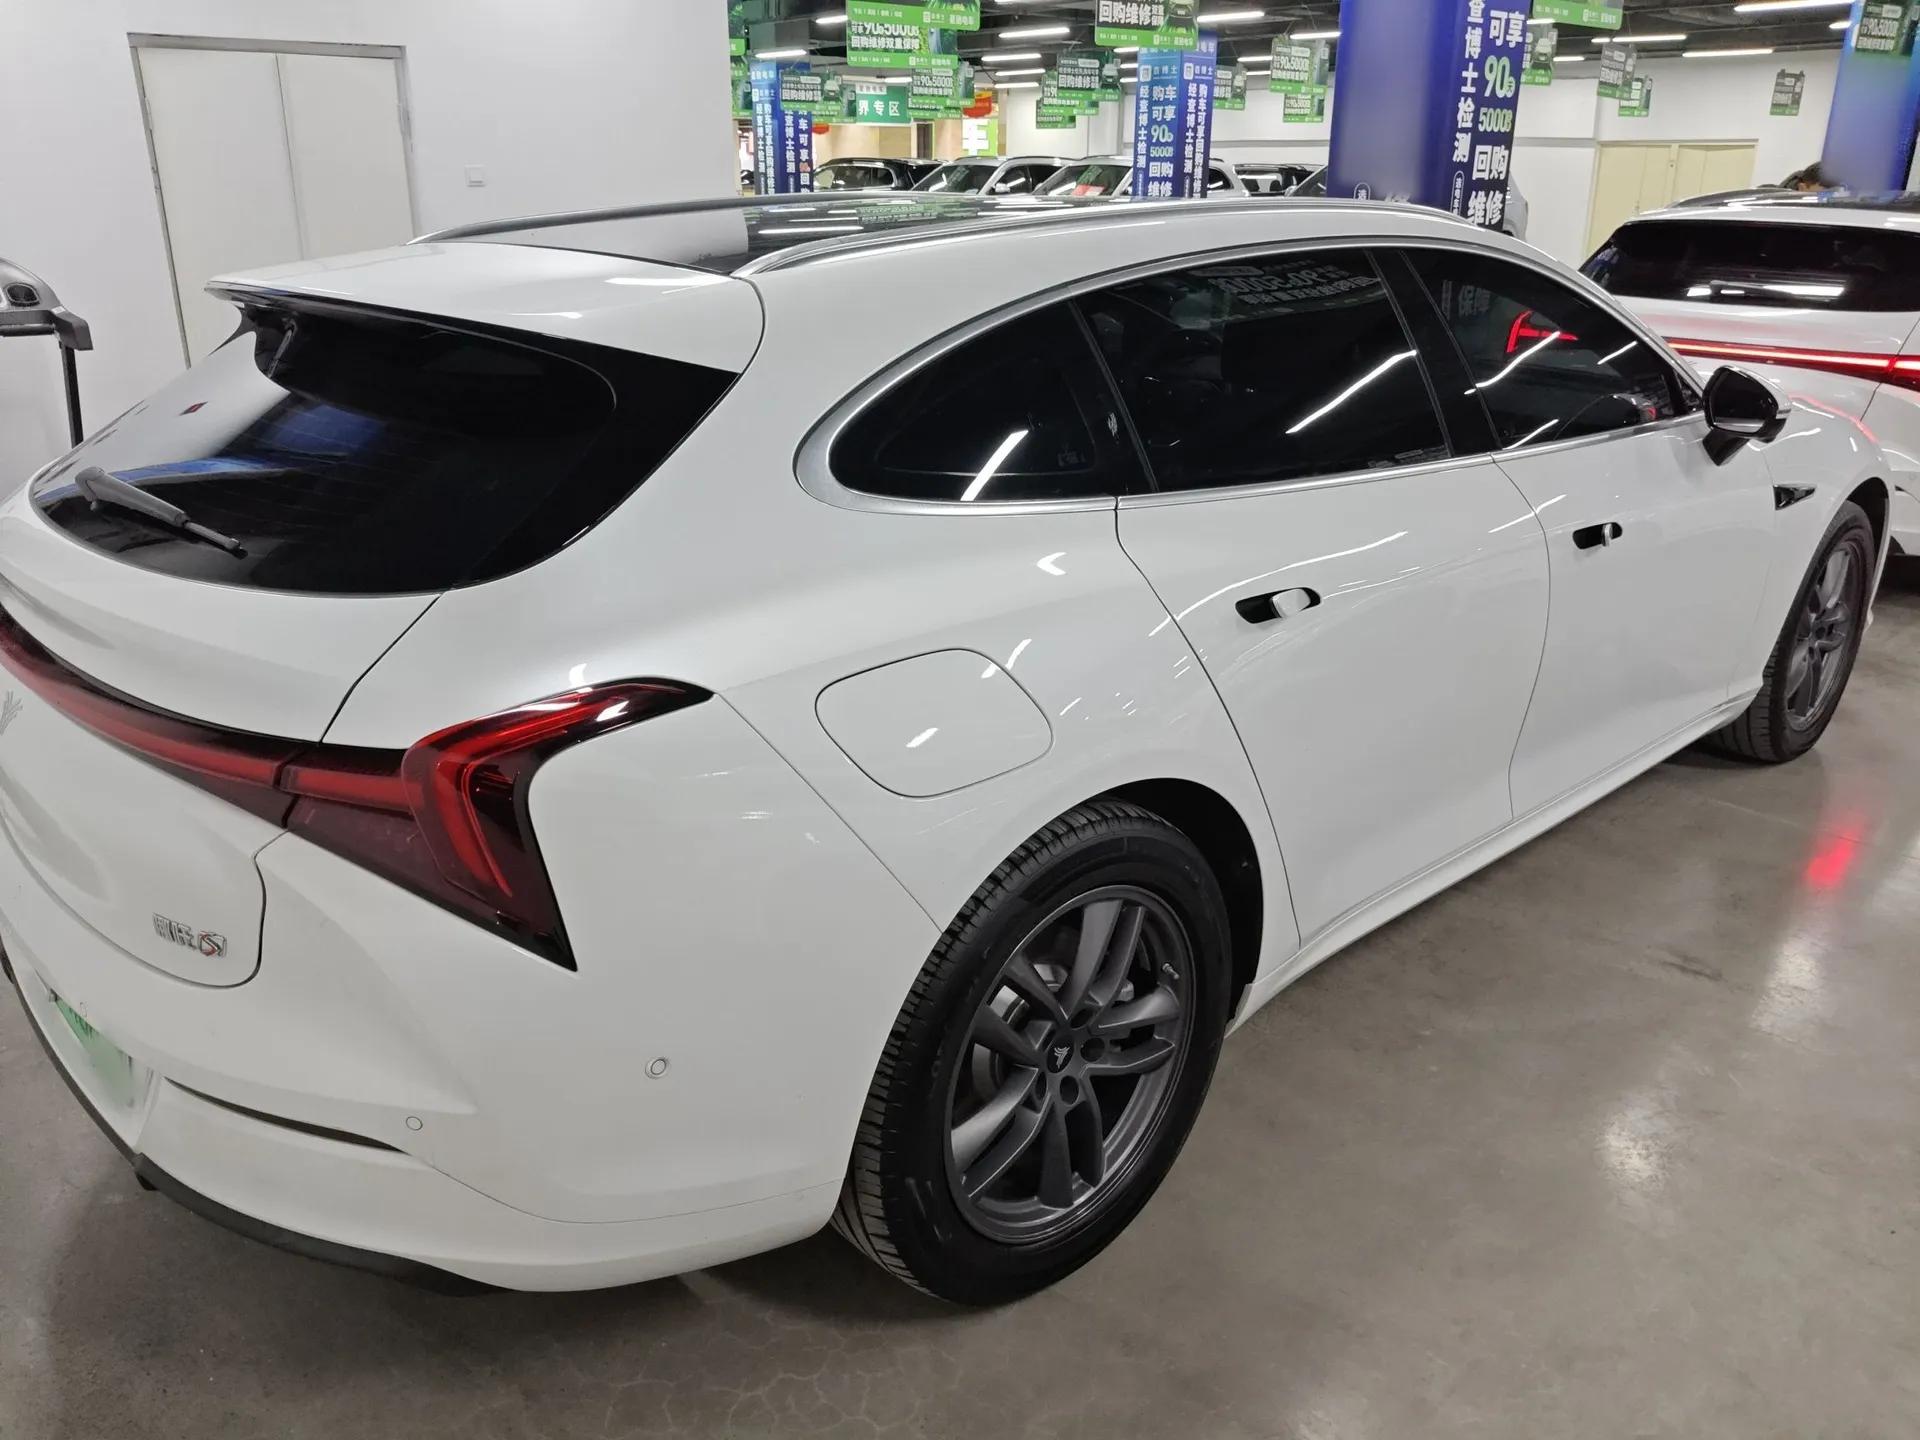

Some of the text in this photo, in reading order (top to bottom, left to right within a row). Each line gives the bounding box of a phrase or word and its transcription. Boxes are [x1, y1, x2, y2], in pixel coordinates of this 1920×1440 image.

[1099, 1, 1152, 25] 回购维修
[1489, 10, 1525, 48] 可享
[1148, 161, 1174, 178] 回购
[1472, 145, 1509, 180] 回购
[1466, 190, 1504, 225] 维修
